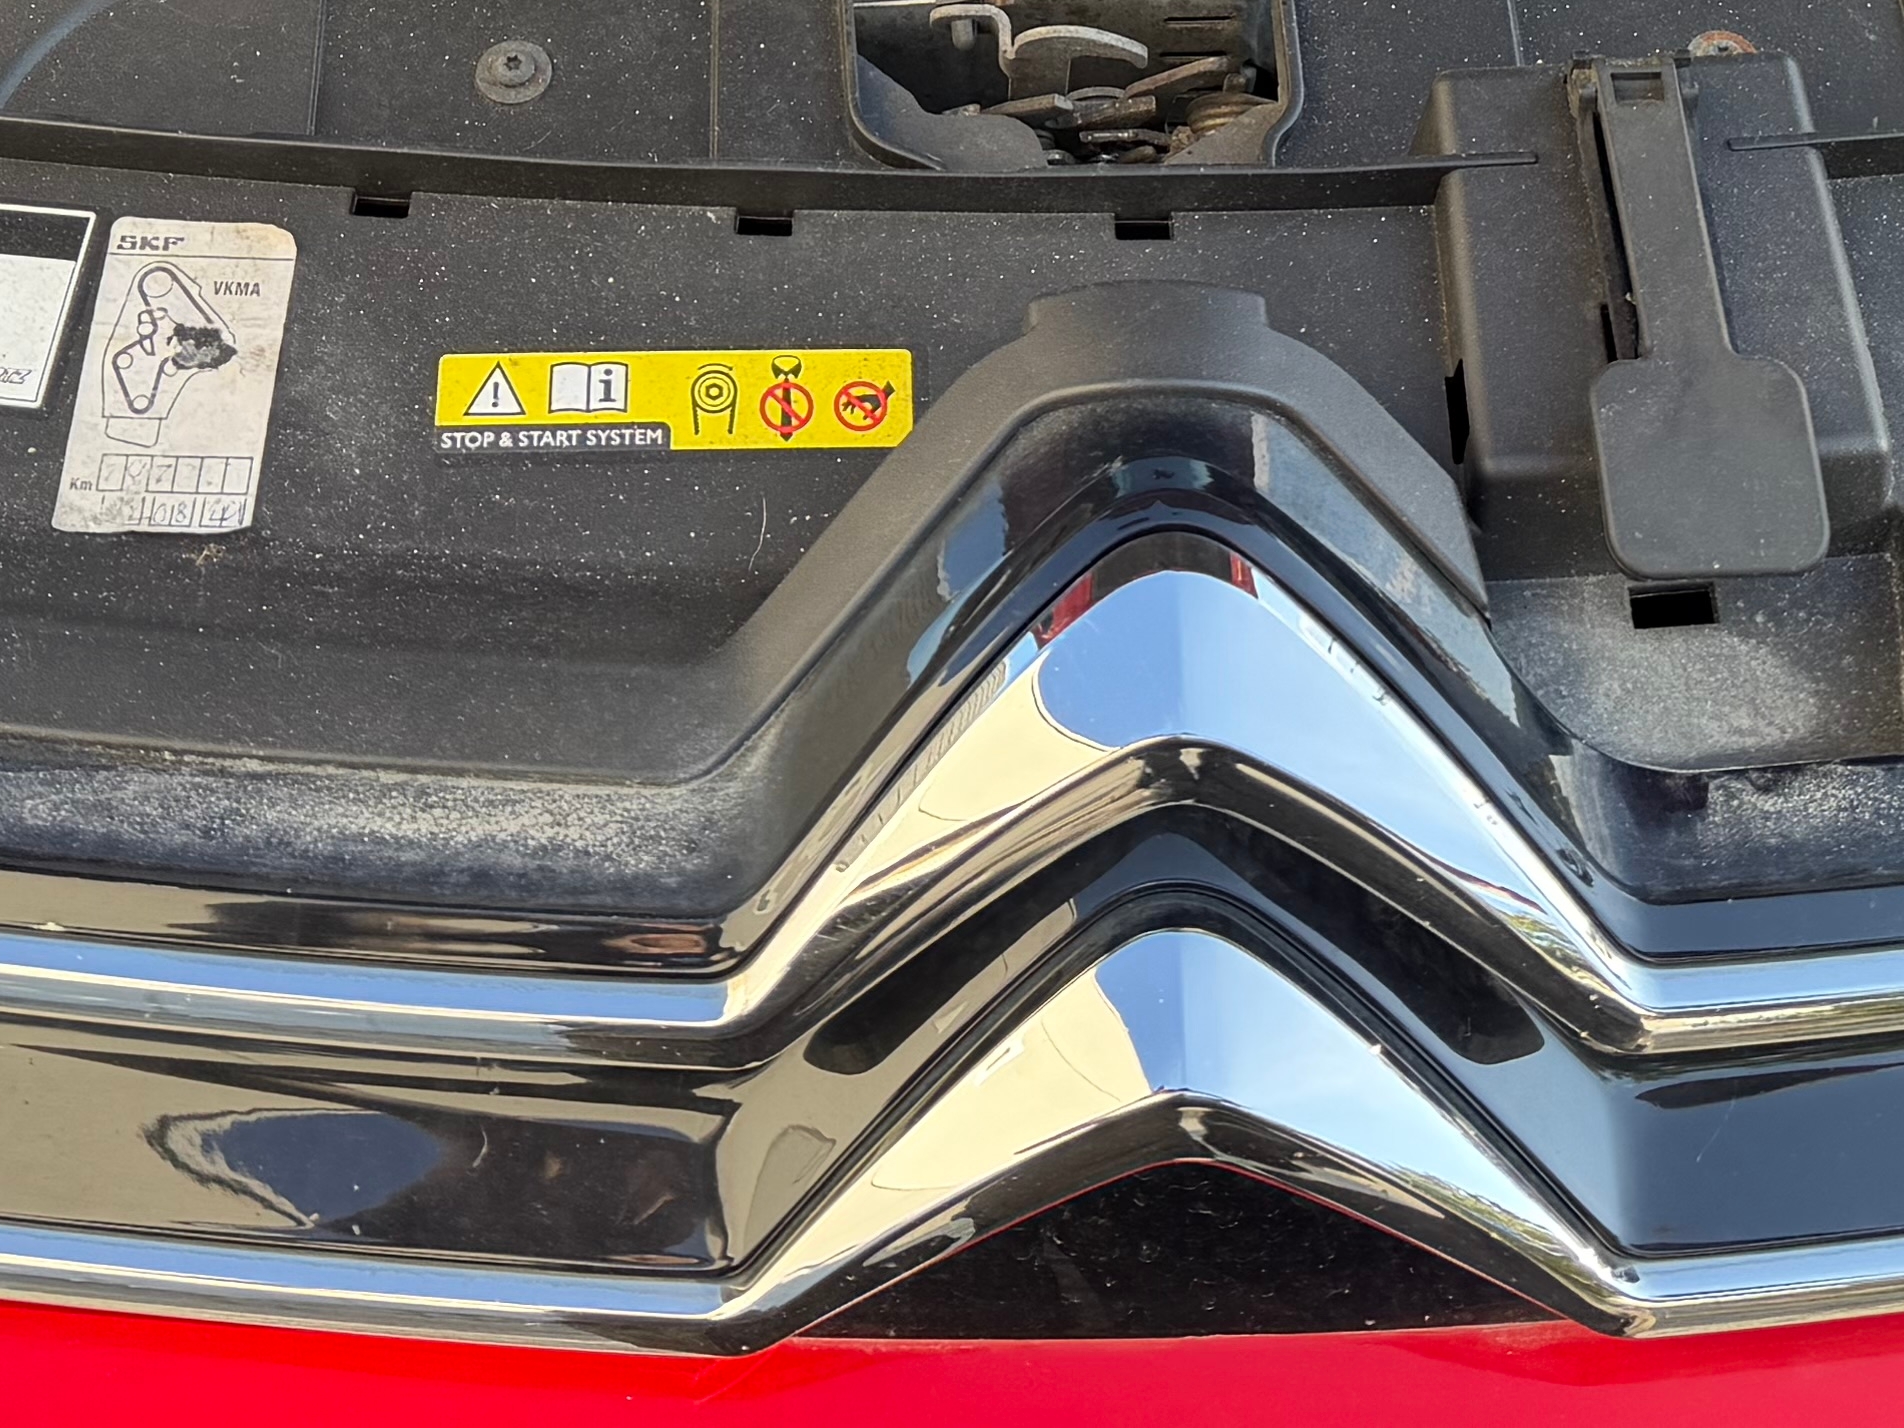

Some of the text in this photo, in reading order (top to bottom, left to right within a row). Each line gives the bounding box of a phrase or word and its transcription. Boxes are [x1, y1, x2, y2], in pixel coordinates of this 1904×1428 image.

[117, 235, 185, 251] SKF
[213, 280, 261, 297] VKMA
[440, 426, 663, 450] STOP & START SYSTEM
[69, 477, 93, 492] Km
